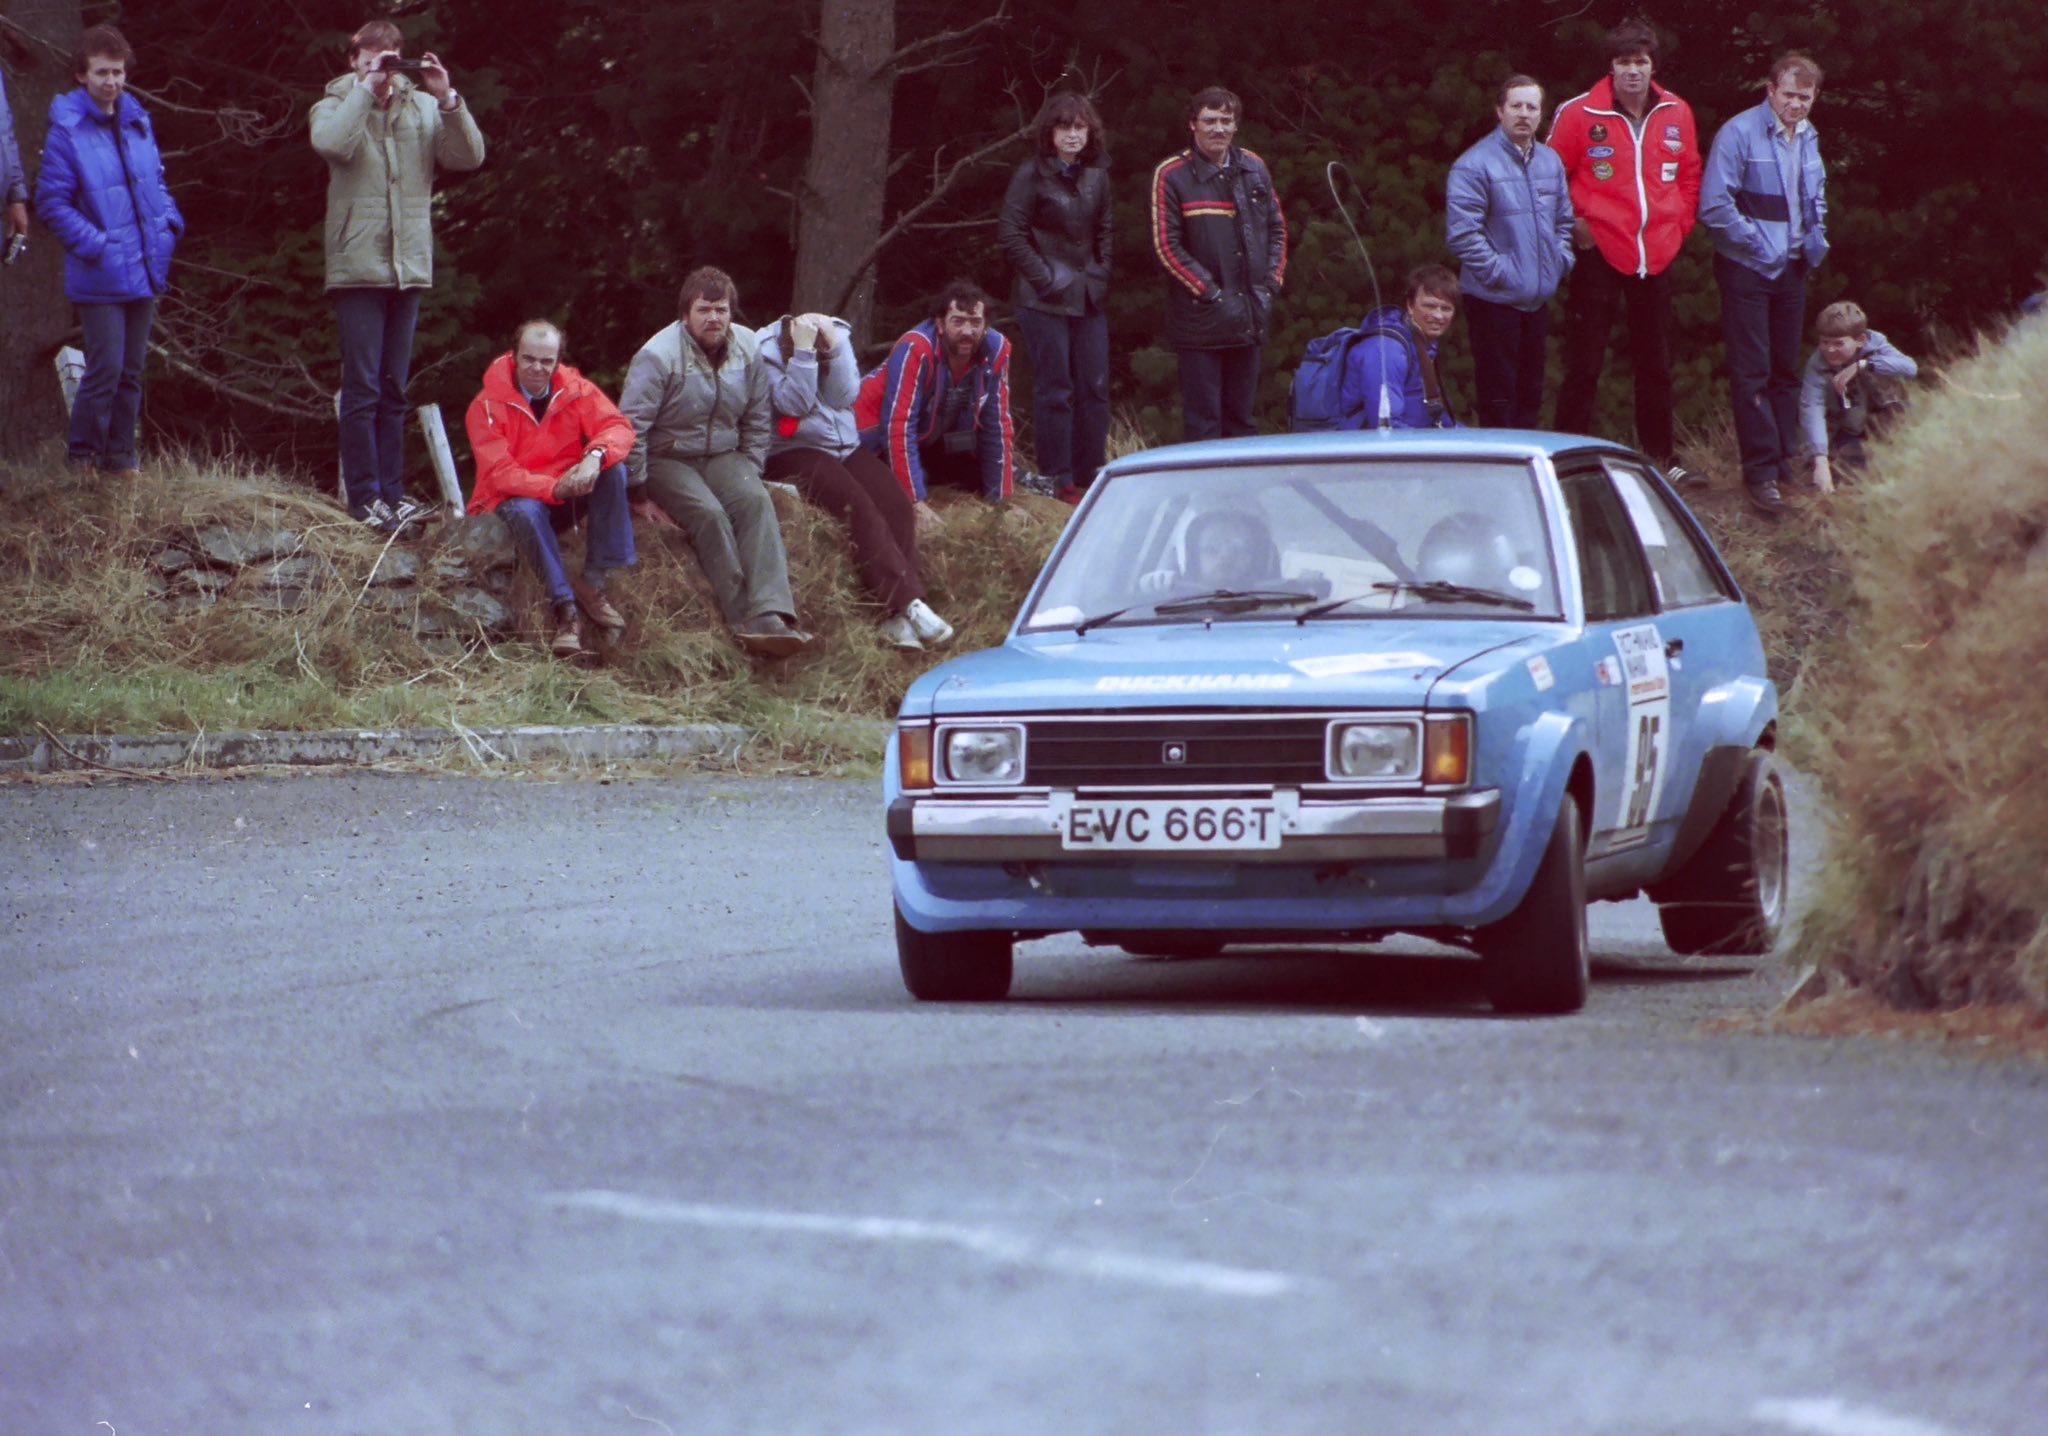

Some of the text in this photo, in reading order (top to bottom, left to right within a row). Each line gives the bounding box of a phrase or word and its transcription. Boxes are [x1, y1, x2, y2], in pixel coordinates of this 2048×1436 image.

[1095, 674, 1292, 692] DUCKHAMS
[1069, 806, 1275, 843] EVC 666T
